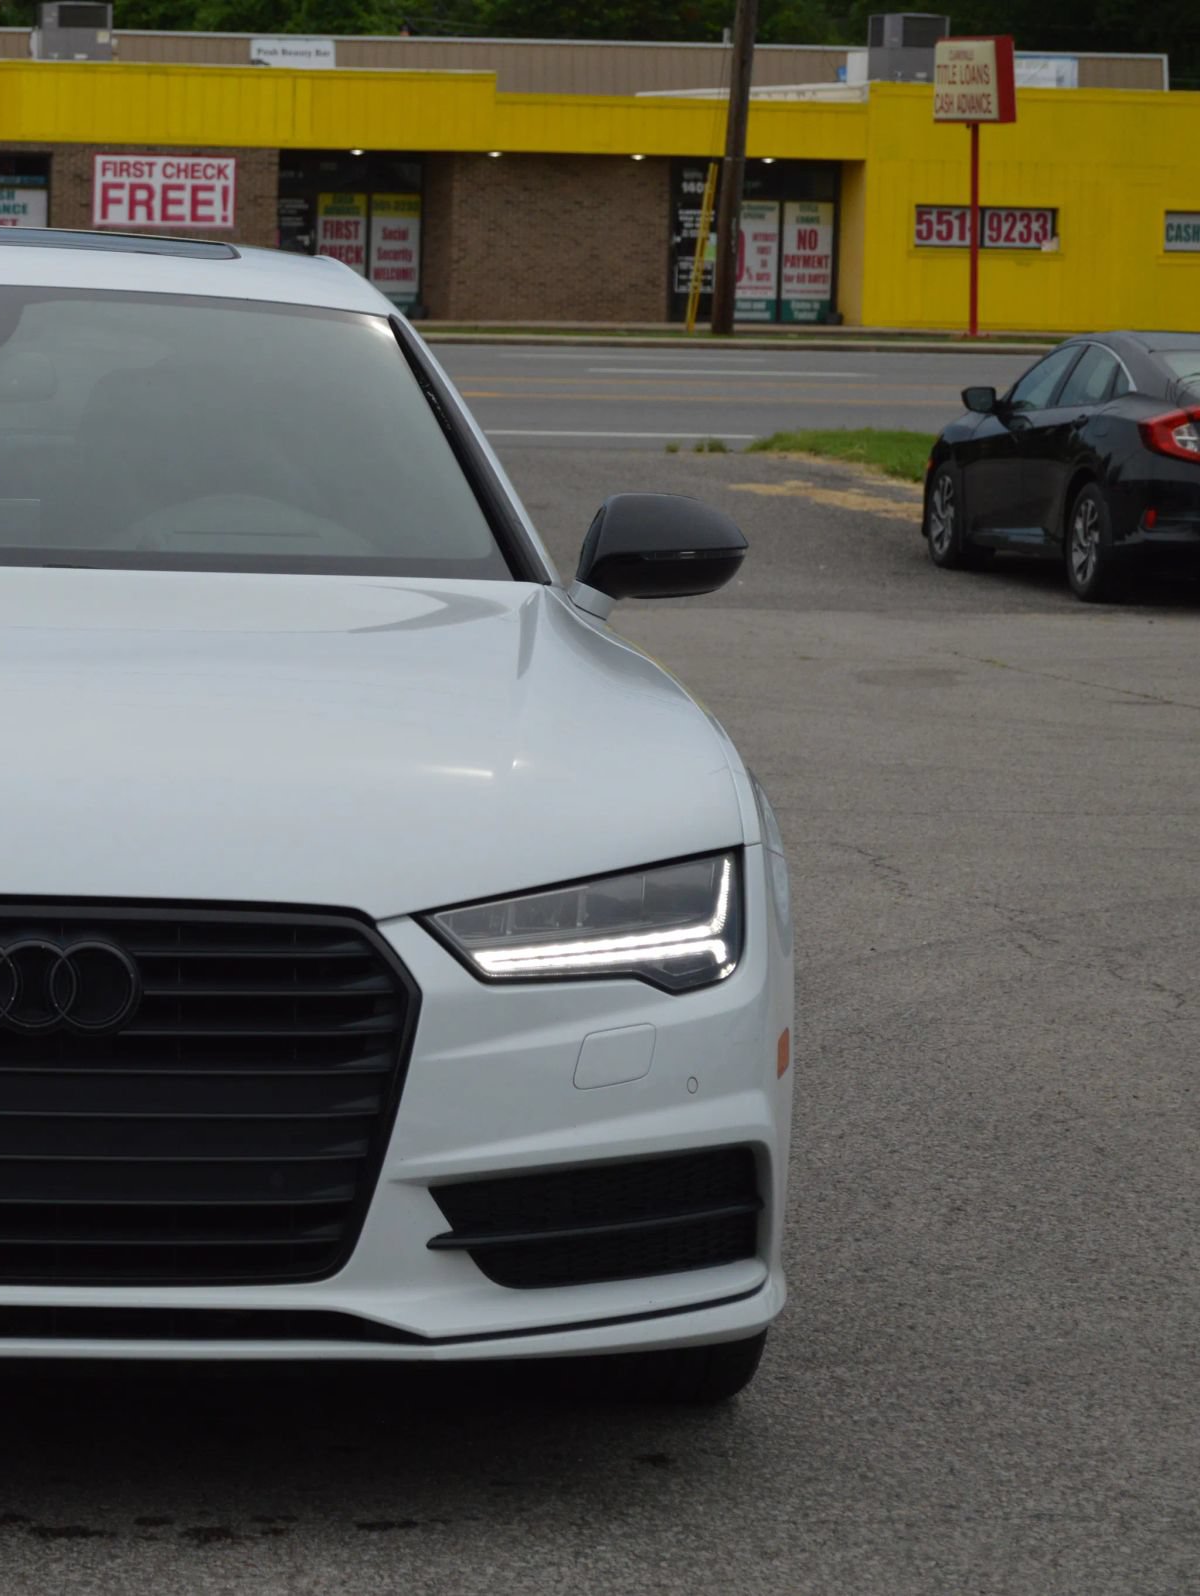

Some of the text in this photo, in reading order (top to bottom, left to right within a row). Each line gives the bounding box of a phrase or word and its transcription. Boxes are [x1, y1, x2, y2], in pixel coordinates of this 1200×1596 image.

[936, 64, 991, 85] TITLE LOANS
[934, 93, 993, 114] CASH ADVANCE
[101, 160, 230, 180] FIRST CHECK
[101, 182, 229, 223] FREE!
[322, 220, 361, 240] FIRST
[382, 227, 409, 241] Social
[988, 211, 1049, 243] 9233
[1166, 222, 1200, 243] CASH
[797, 228, 818, 251] NO
[376, 248, 413, 263] Security
[784, 254, 829, 269] PAYMENT
